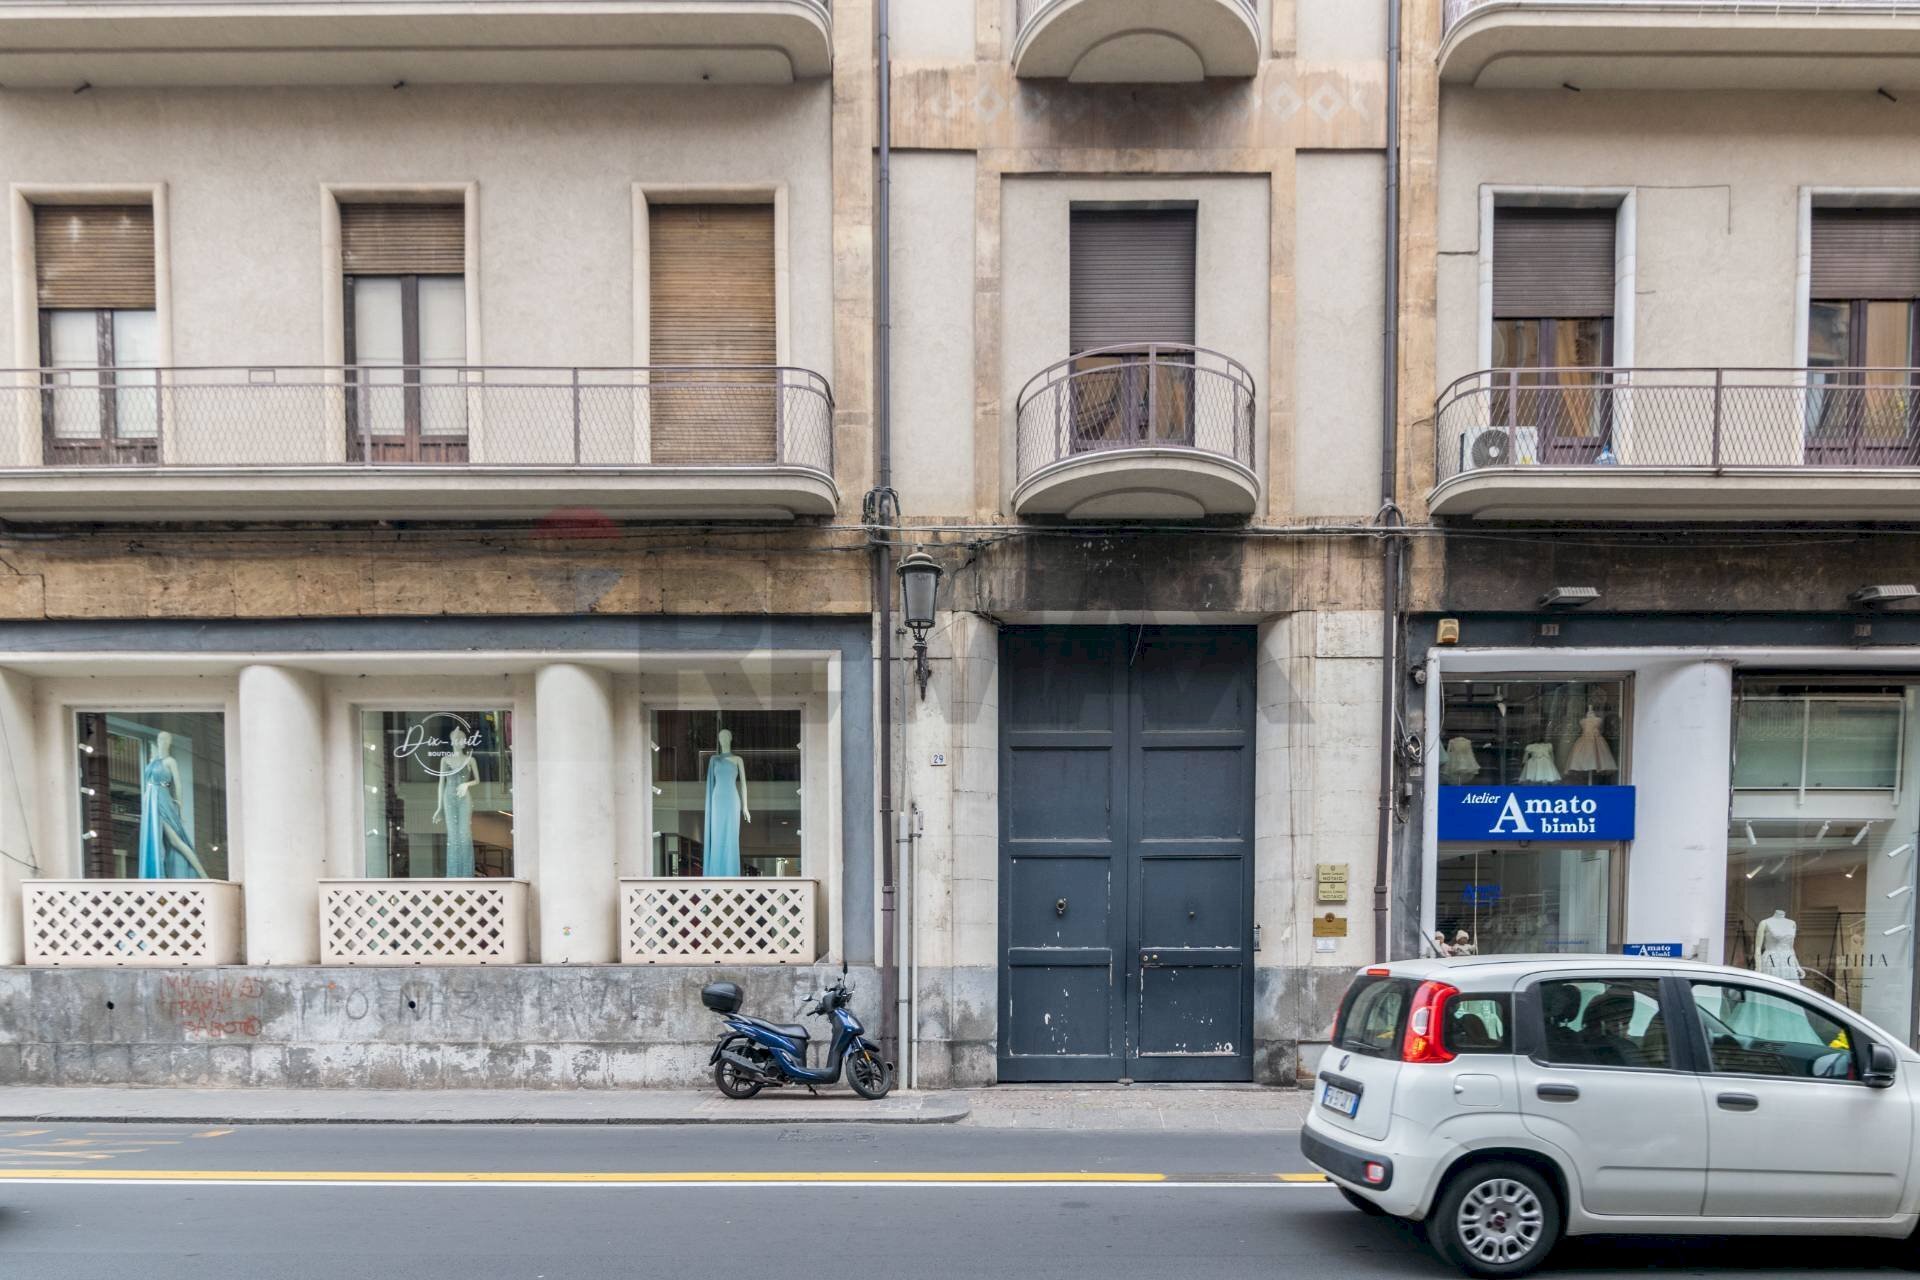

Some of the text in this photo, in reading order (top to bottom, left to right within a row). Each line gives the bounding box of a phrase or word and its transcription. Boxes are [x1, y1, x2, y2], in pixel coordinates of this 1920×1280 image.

[933, 754, 944, 764] 29
[1461, 791, 1597, 834] Atelier Amato
[1540, 817, 1596, 834] bimbi
